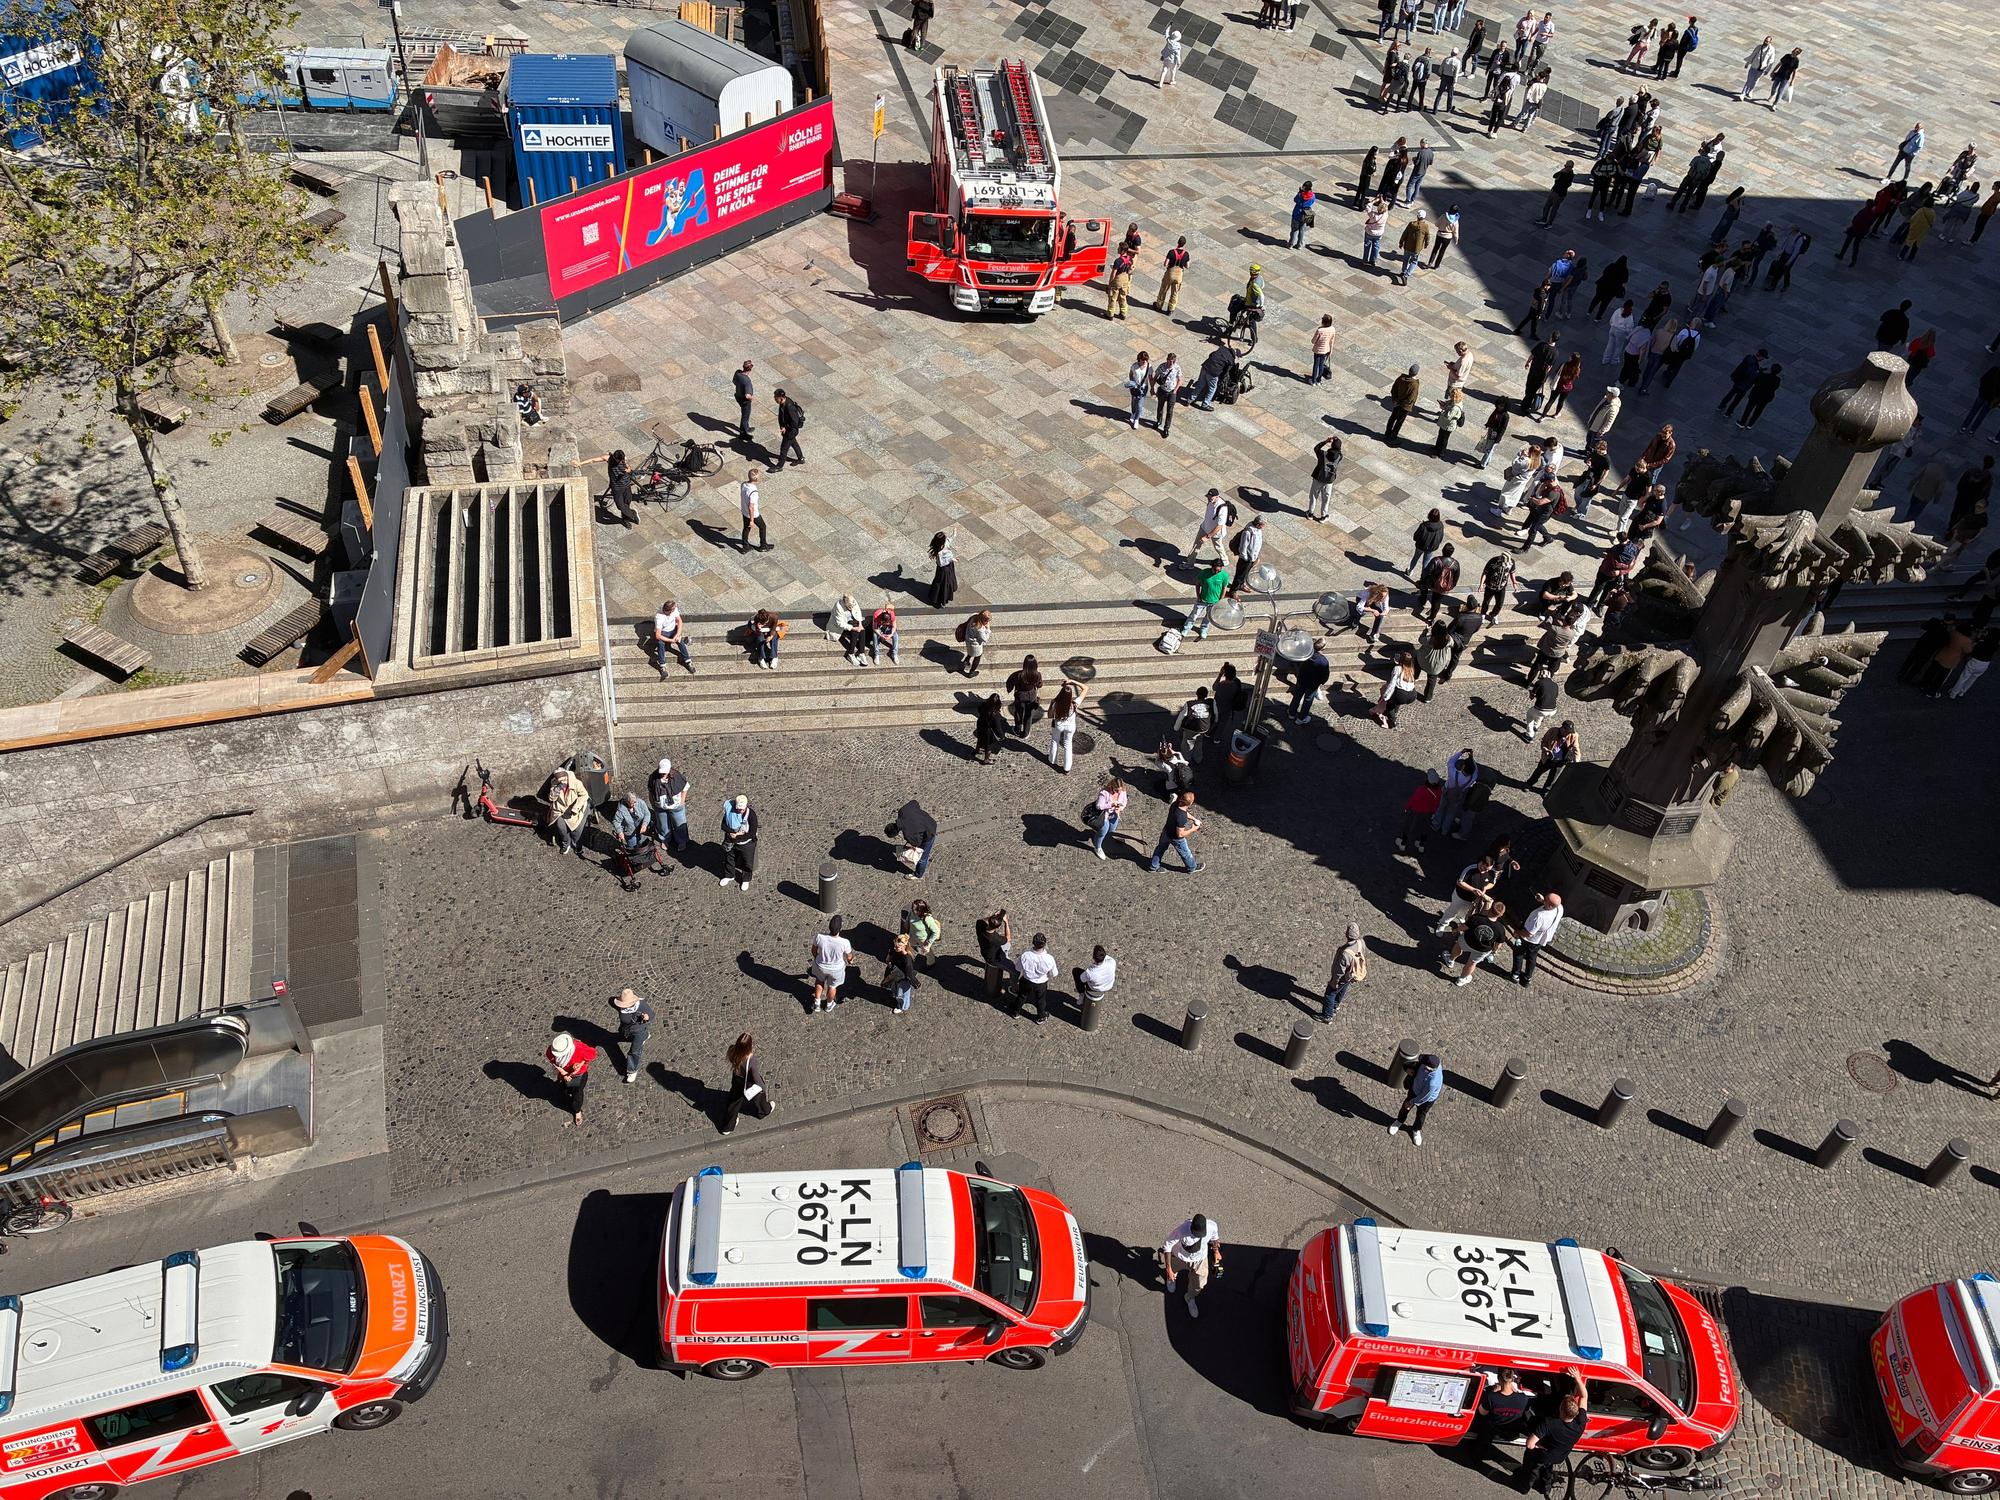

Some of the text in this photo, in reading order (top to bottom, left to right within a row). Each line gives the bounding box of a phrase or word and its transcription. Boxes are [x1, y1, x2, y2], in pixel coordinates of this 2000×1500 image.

[546, 136, 610, 146] HOCHTIEF
[788, 126, 813, 145] KÖLN
[713, 163, 742, 183] DEINE
[715, 171, 750, 194] STIMME
[751, 164, 768, 180] FÜR
[644, 183, 662, 196] DEIN
[716, 191, 732, 206] DIE
[733, 178, 763, 199] SPIELE
[974, 186, 1044, 197] K-LN 3691
[717, 194, 756, 218] IN KÖLN.
[988, 263, 1030, 271] Feuerwehr
[797, 1182, 828, 1265] 3670
[841, 1179, 872, 1266] K-LN
[1072, 1226, 1085, 1288] FEUERWEHR
[388, 1262, 408, 1331] NOTARZT
[412, 1257, 427, 1336] RETTUNGSDIENST
[1453, 1245, 1498, 1332] 3667
[1495, 1247, 1543, 1339] K-LN
[684, 1335, 800, 1343] EINSATZLEITUNG
[1357, 1340, 1474, 1360] Feuerwehr 112
[1699, 1310, 1732, 1404] Feuerwehr
[1369, 1412, 1463, 1431] Einsatzleitung
[1920, 1407, 1931, 1424] 112
[4, 1428, 75, 1450] RETTUNGSDIENST
[52, 1436, 76, 1450] 112
[25, 1458, 89, 1479] NOTARZT
